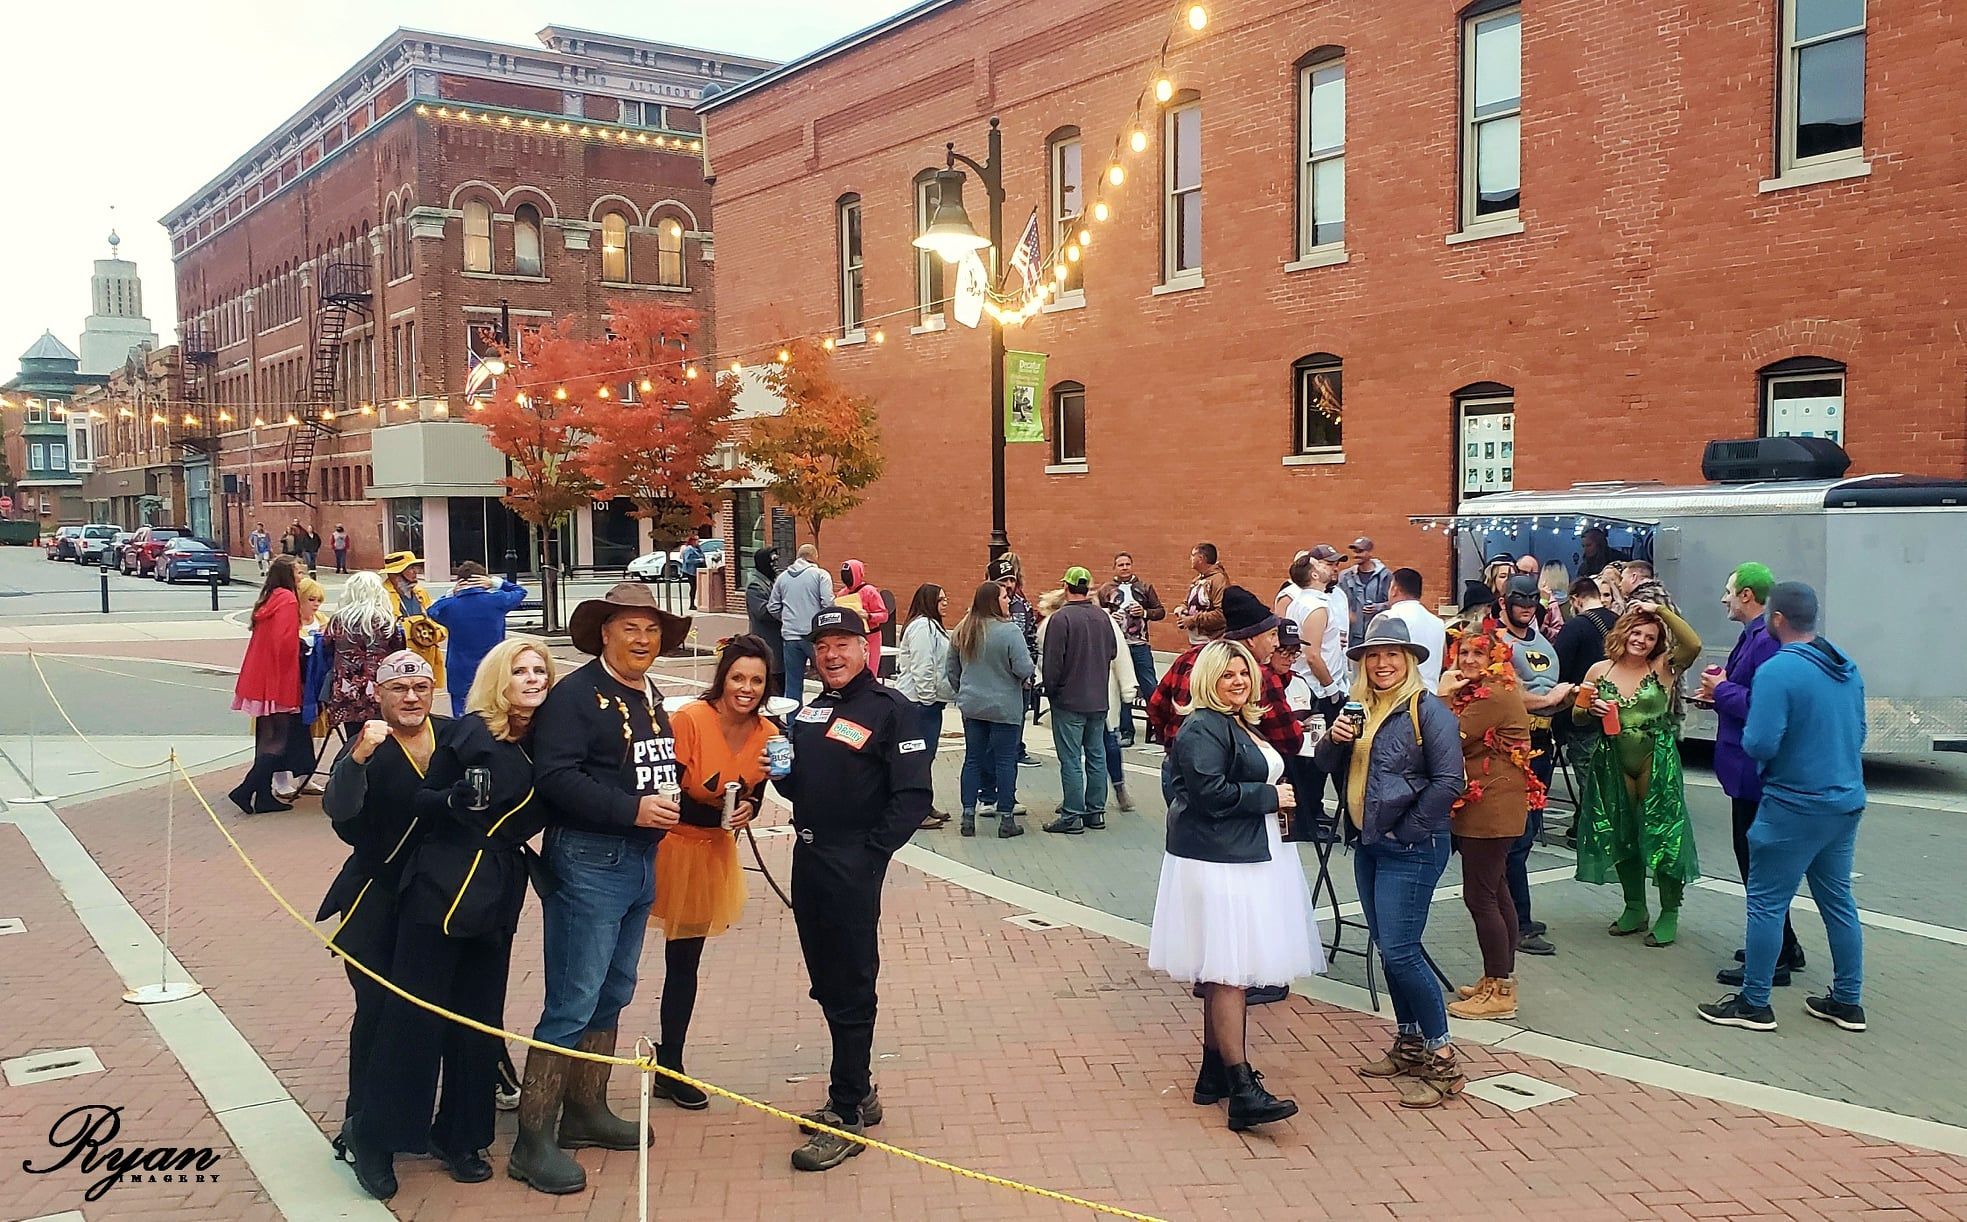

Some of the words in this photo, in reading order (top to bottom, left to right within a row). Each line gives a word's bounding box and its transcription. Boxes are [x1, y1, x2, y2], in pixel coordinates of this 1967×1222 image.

[628, 80, 691, 98] ALLISON
[592, 501, 609, 511] 101
[404, 663, 416, 673] B
[833, 723, 865, 742] O'Reilly
